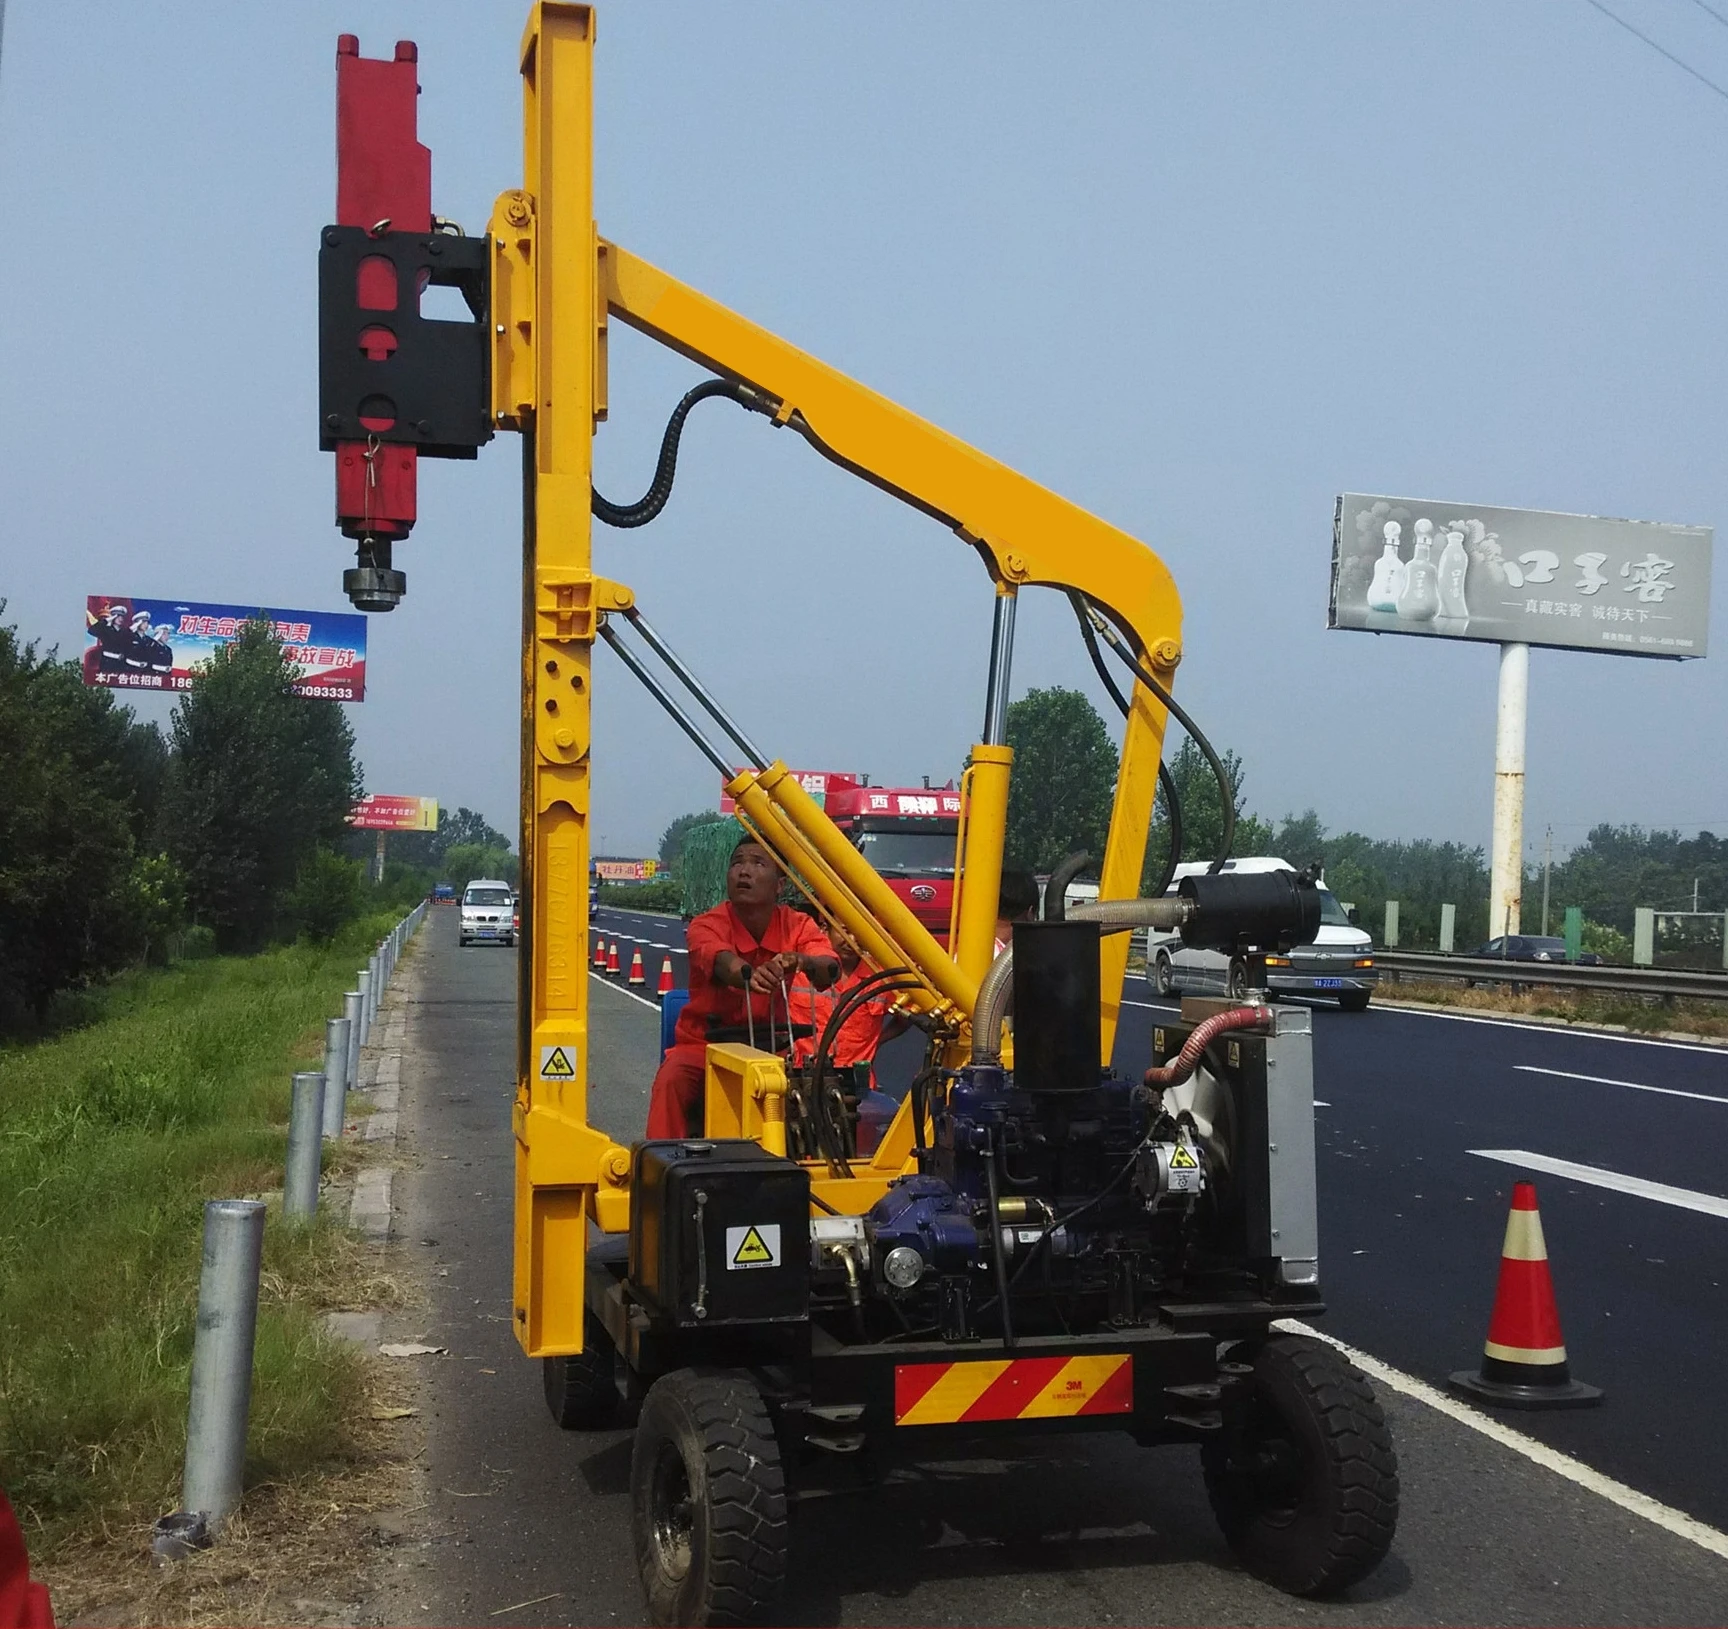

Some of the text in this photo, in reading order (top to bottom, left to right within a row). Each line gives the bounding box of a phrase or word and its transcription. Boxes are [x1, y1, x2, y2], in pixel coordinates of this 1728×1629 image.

[1502, 549, 1676, 604] 口子窖
[1525, 599, 1649, 623] 真藏实窖 诚待天下
[177, 614, 311, 643] 对生命负责
[95, 672, 162, 687] 本广告位招商
[869, 794, 889, 809] 西
[1066, 1380, 1082, 1391] 3M
